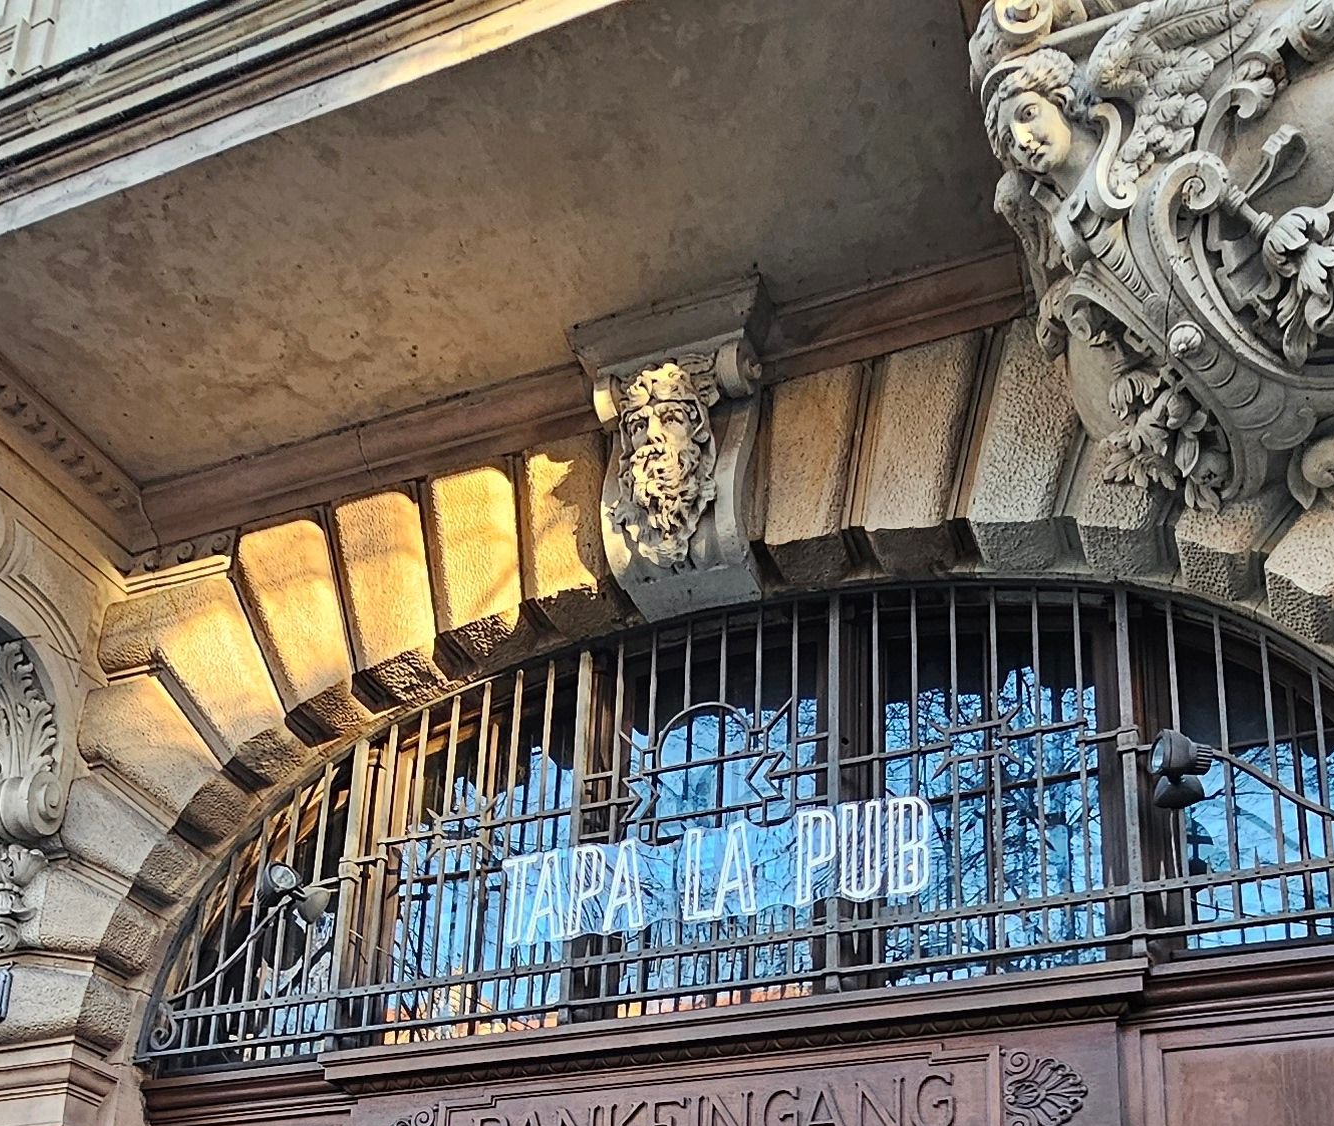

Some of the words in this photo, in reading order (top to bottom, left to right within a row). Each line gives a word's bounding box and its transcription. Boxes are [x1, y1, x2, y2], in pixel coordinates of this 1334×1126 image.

[502, 836, 645, 946] TAPA
[683, 819, 757, 922] LA
[794, 796, 932, 906] PUB
